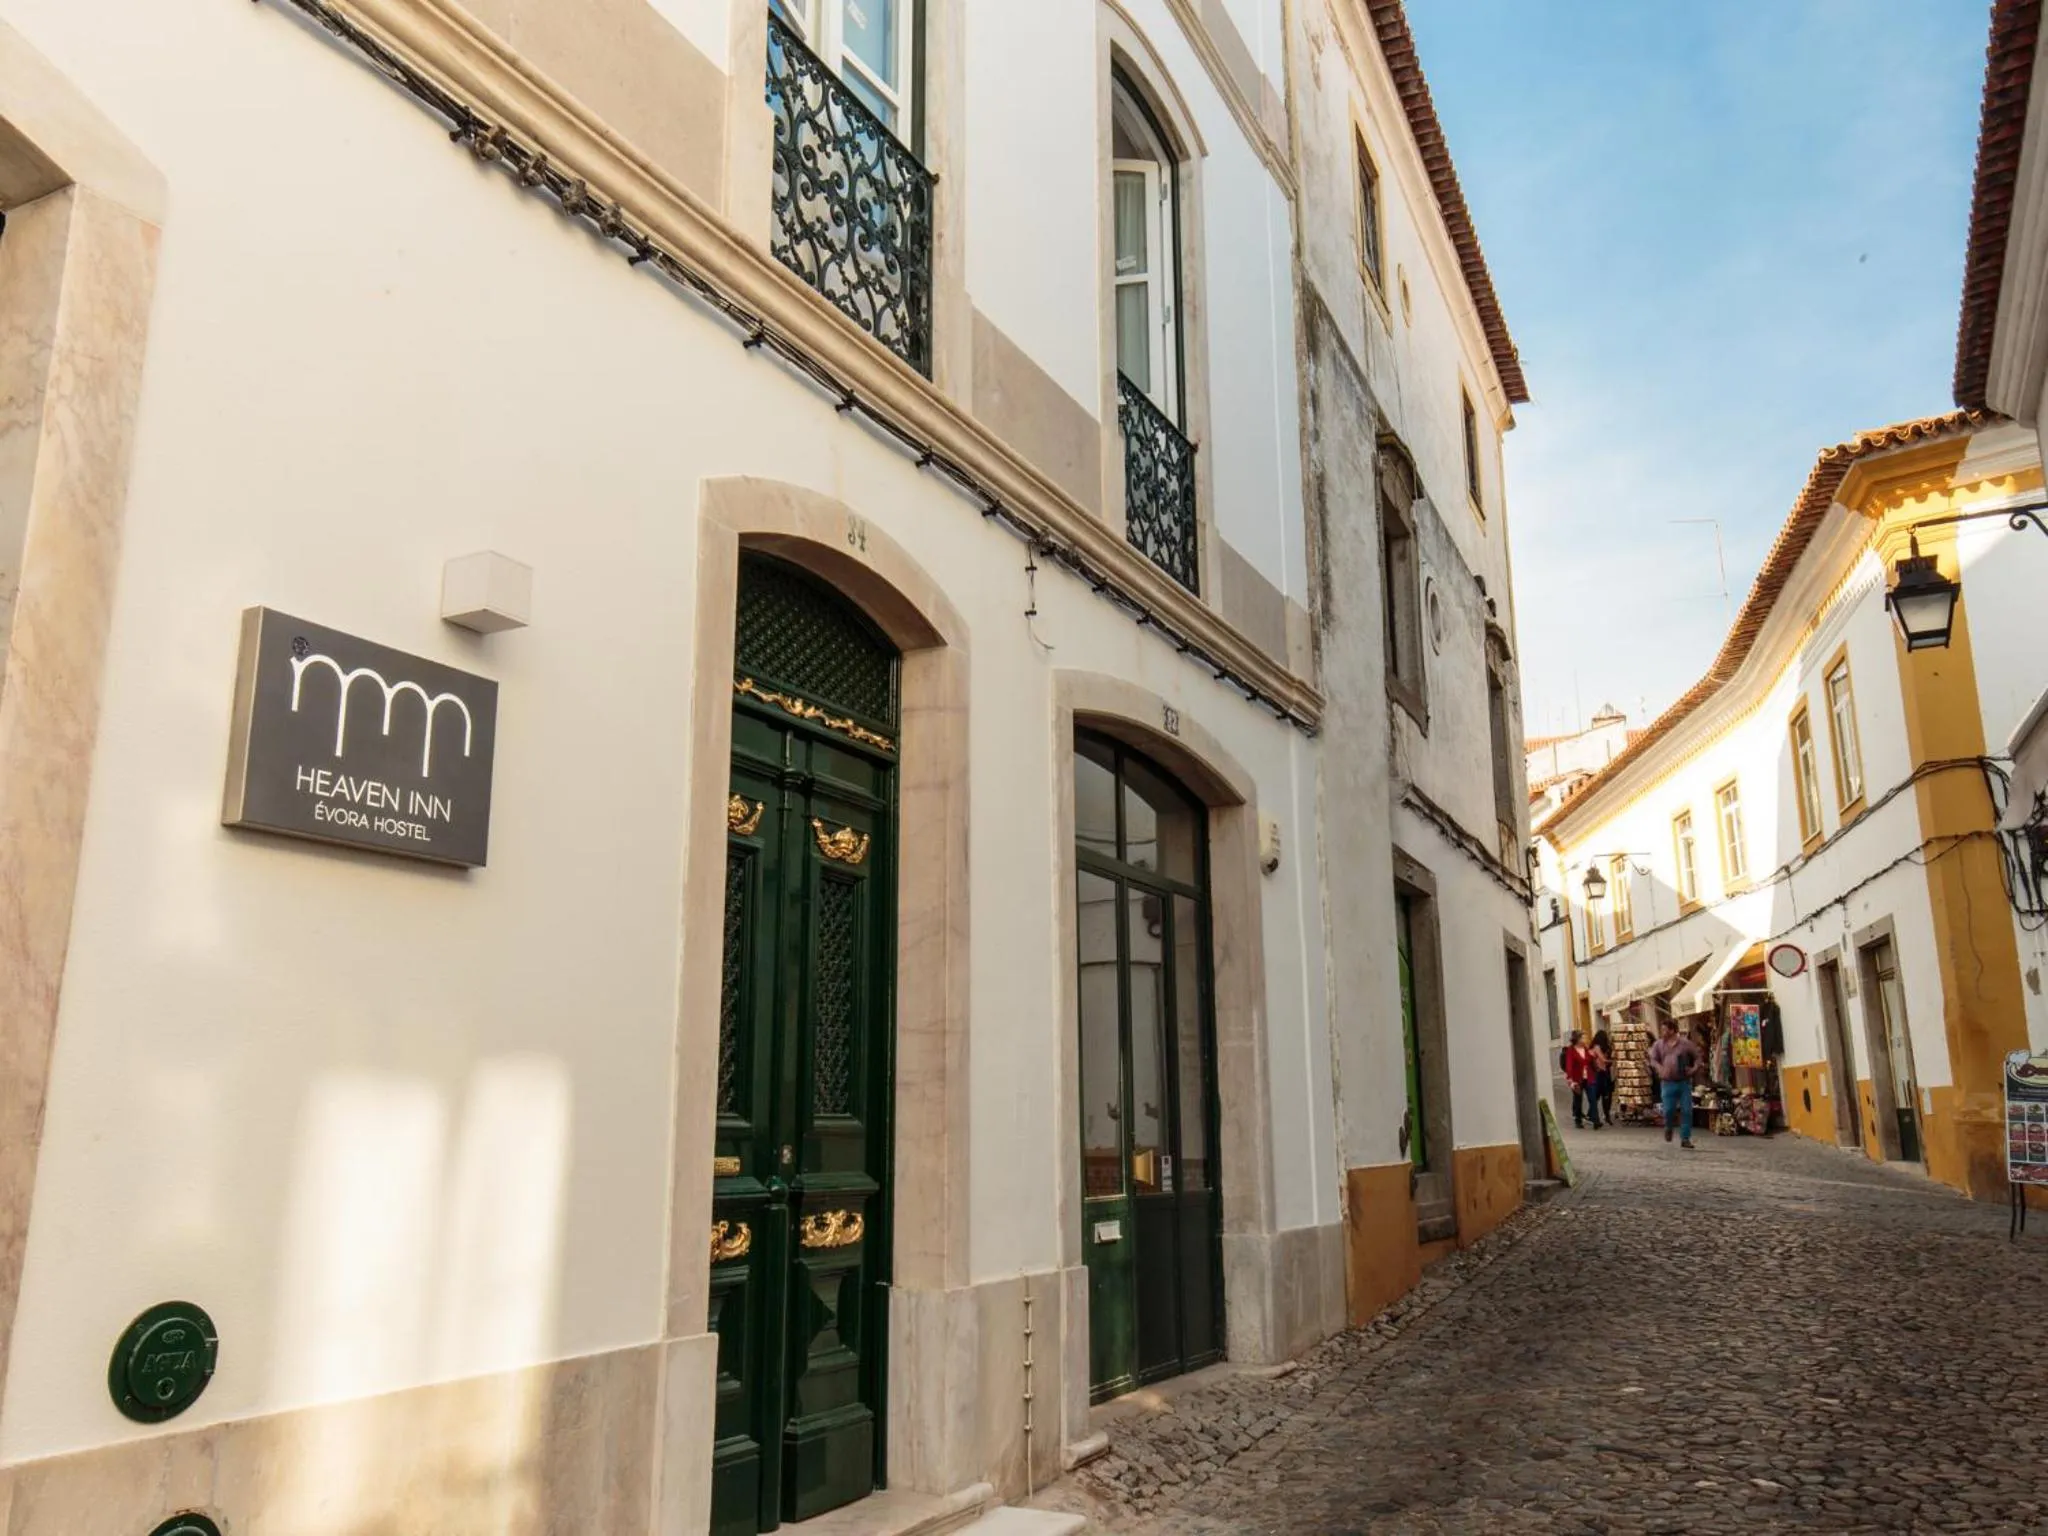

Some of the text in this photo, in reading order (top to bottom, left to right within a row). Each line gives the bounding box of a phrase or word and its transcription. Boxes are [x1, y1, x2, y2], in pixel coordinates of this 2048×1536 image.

[296, 765, 451, 823] HEAVEN INN
[314, 801, 431, 842] ÉVORA HOSTEL
